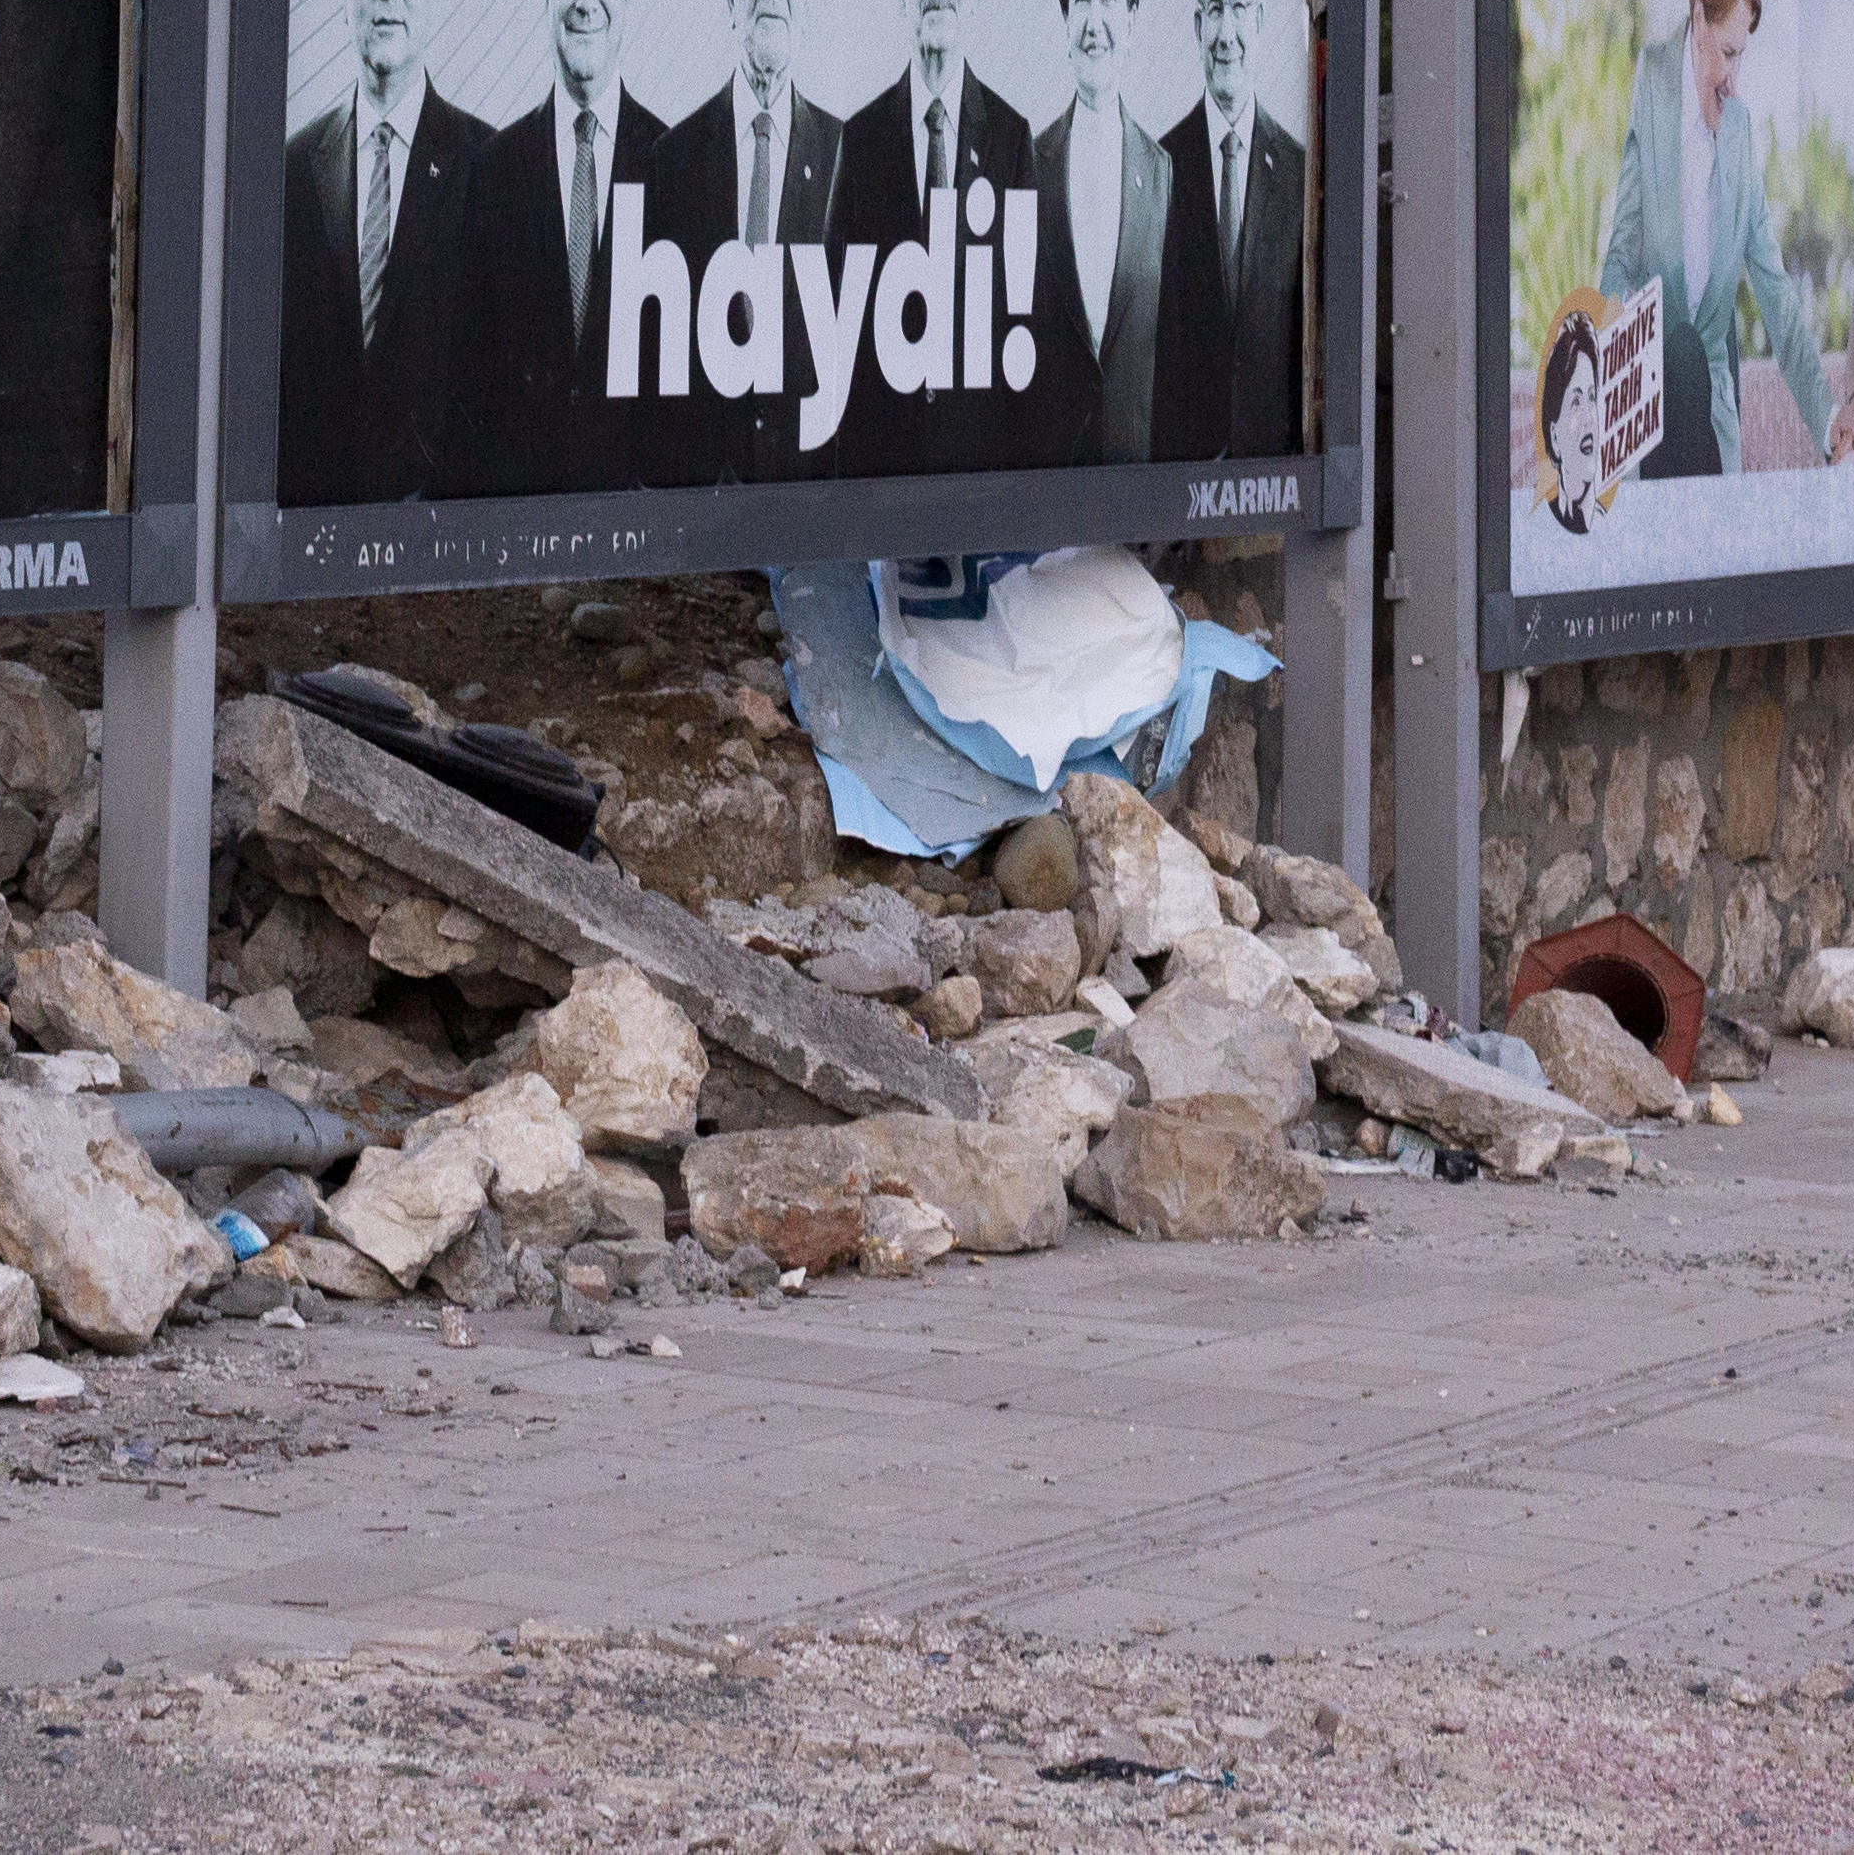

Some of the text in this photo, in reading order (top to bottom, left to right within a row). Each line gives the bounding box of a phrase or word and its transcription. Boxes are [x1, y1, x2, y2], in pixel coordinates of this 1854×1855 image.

[606, 178, 1039, 451] haydi!
[1602, 300, 1656, 386] TÜRKİYE
[1601, 390, 1660, 481] YAZACAK
[1604, 360, 1643, 433] TARİH
[1199, 475, 1302, 519] KARMA
